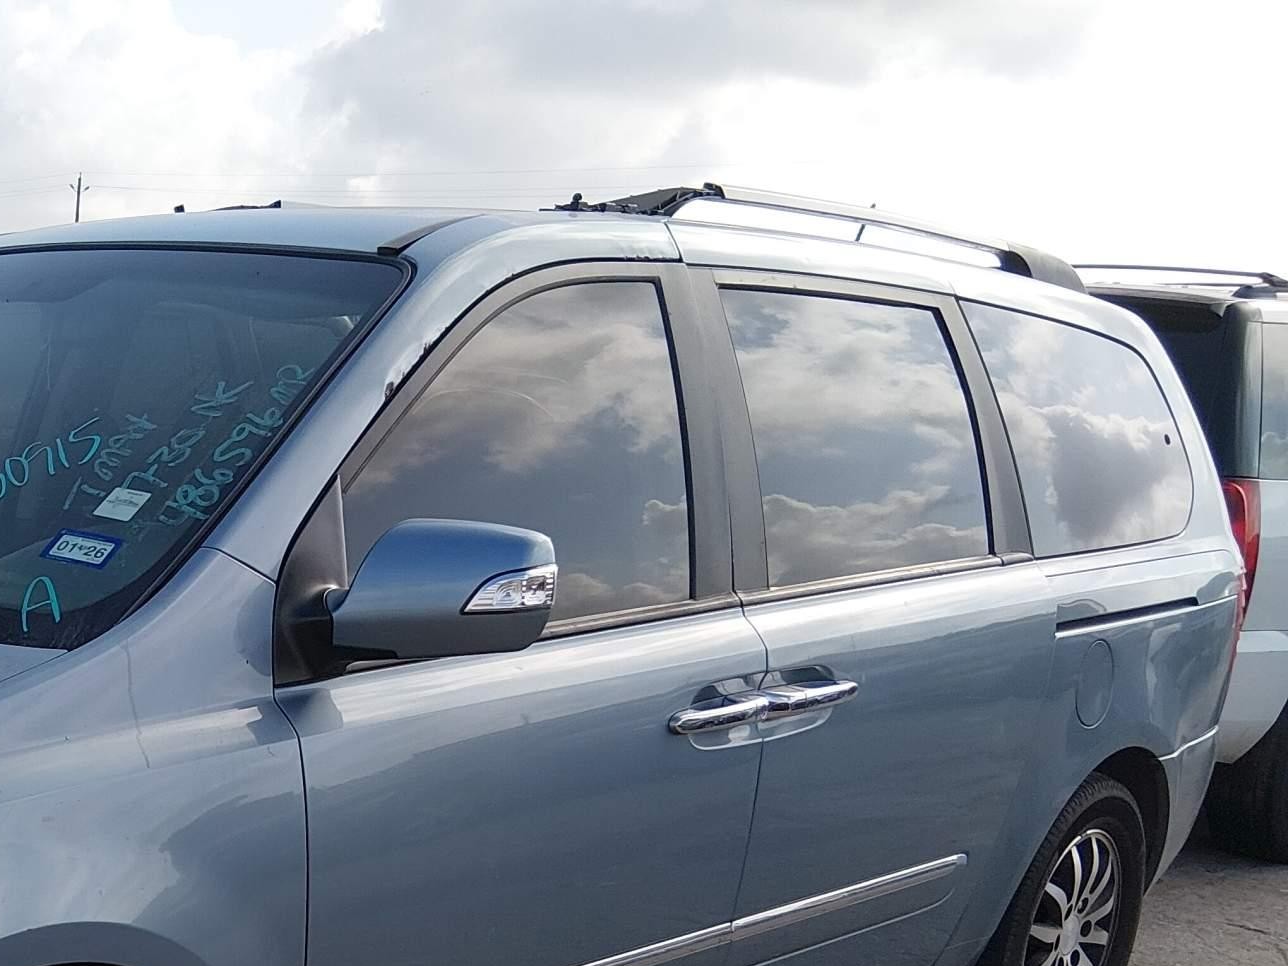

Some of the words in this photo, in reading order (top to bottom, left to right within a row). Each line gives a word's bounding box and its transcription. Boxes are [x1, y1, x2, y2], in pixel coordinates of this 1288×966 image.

[56, 540, 80, 553] 01
[82, 545, 108, 559] 26
[20, 575, 62, 632] A
